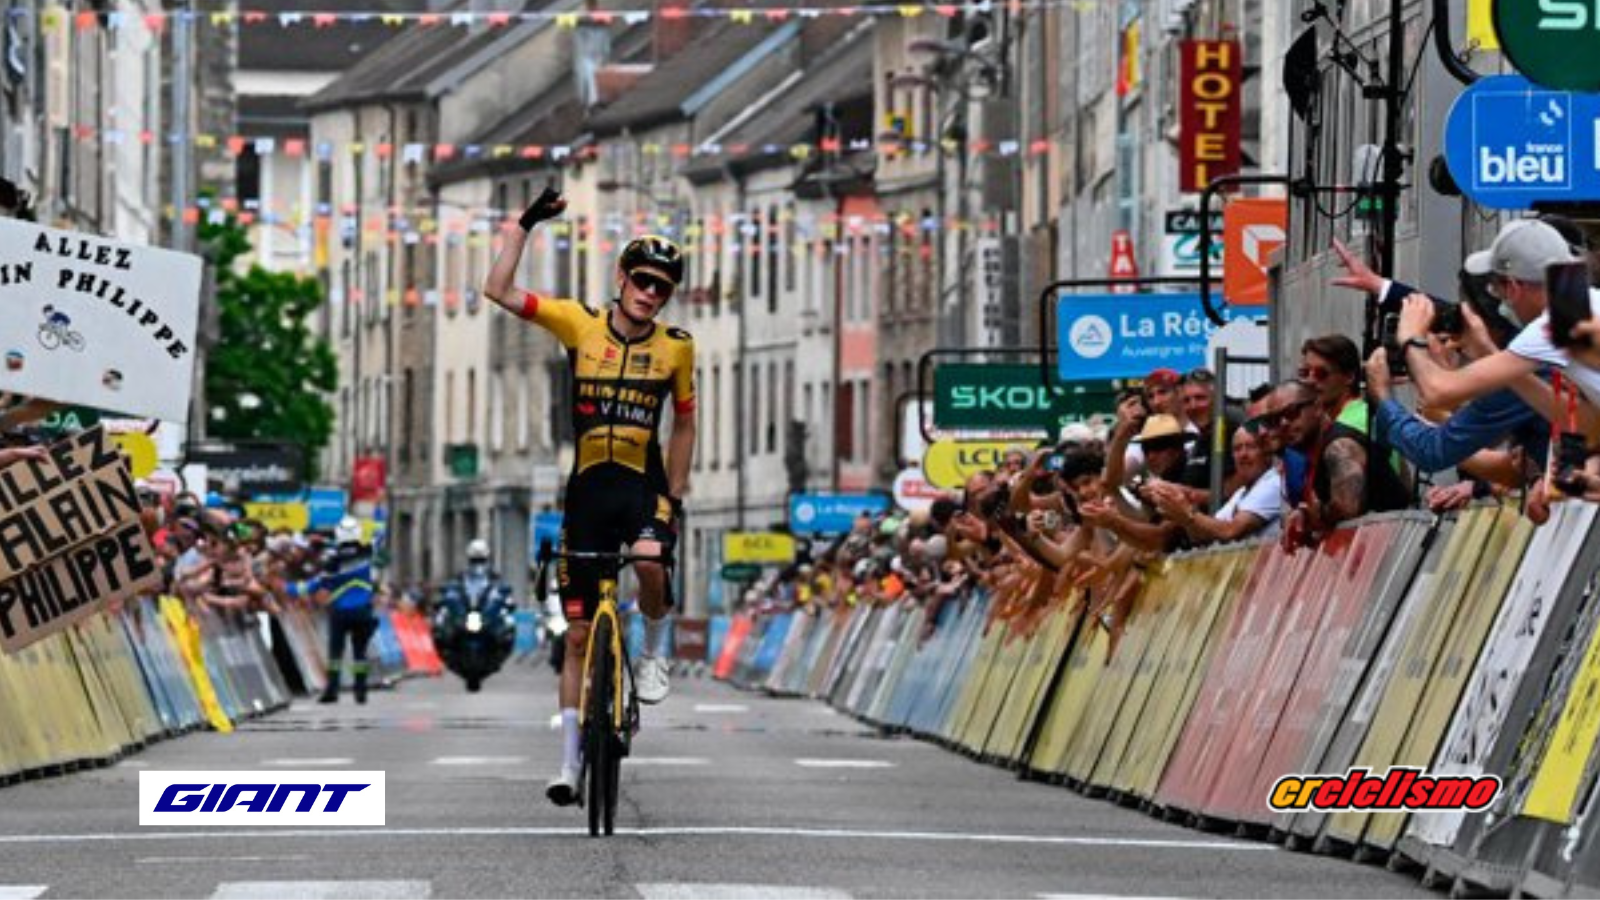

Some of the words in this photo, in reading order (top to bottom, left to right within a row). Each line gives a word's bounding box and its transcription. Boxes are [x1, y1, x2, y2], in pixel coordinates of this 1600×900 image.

[1192, 42, 1232, 189] HOTEL
[1480, 146, 1564, 182] bleu
[1526, 142, 1564, 153] france
[34, 231, 133, 269] ALLEZ
[0, 262, 32, 285] IN
[57, 268, 189, 359] PHILIPPE
[1120, 313, 1155, 337] La
[1122, 345, 1184, 359] Auvergne
[0, 428, 120, 512] LLEZ
[0, 524, 154, 638] PHILIPPE
